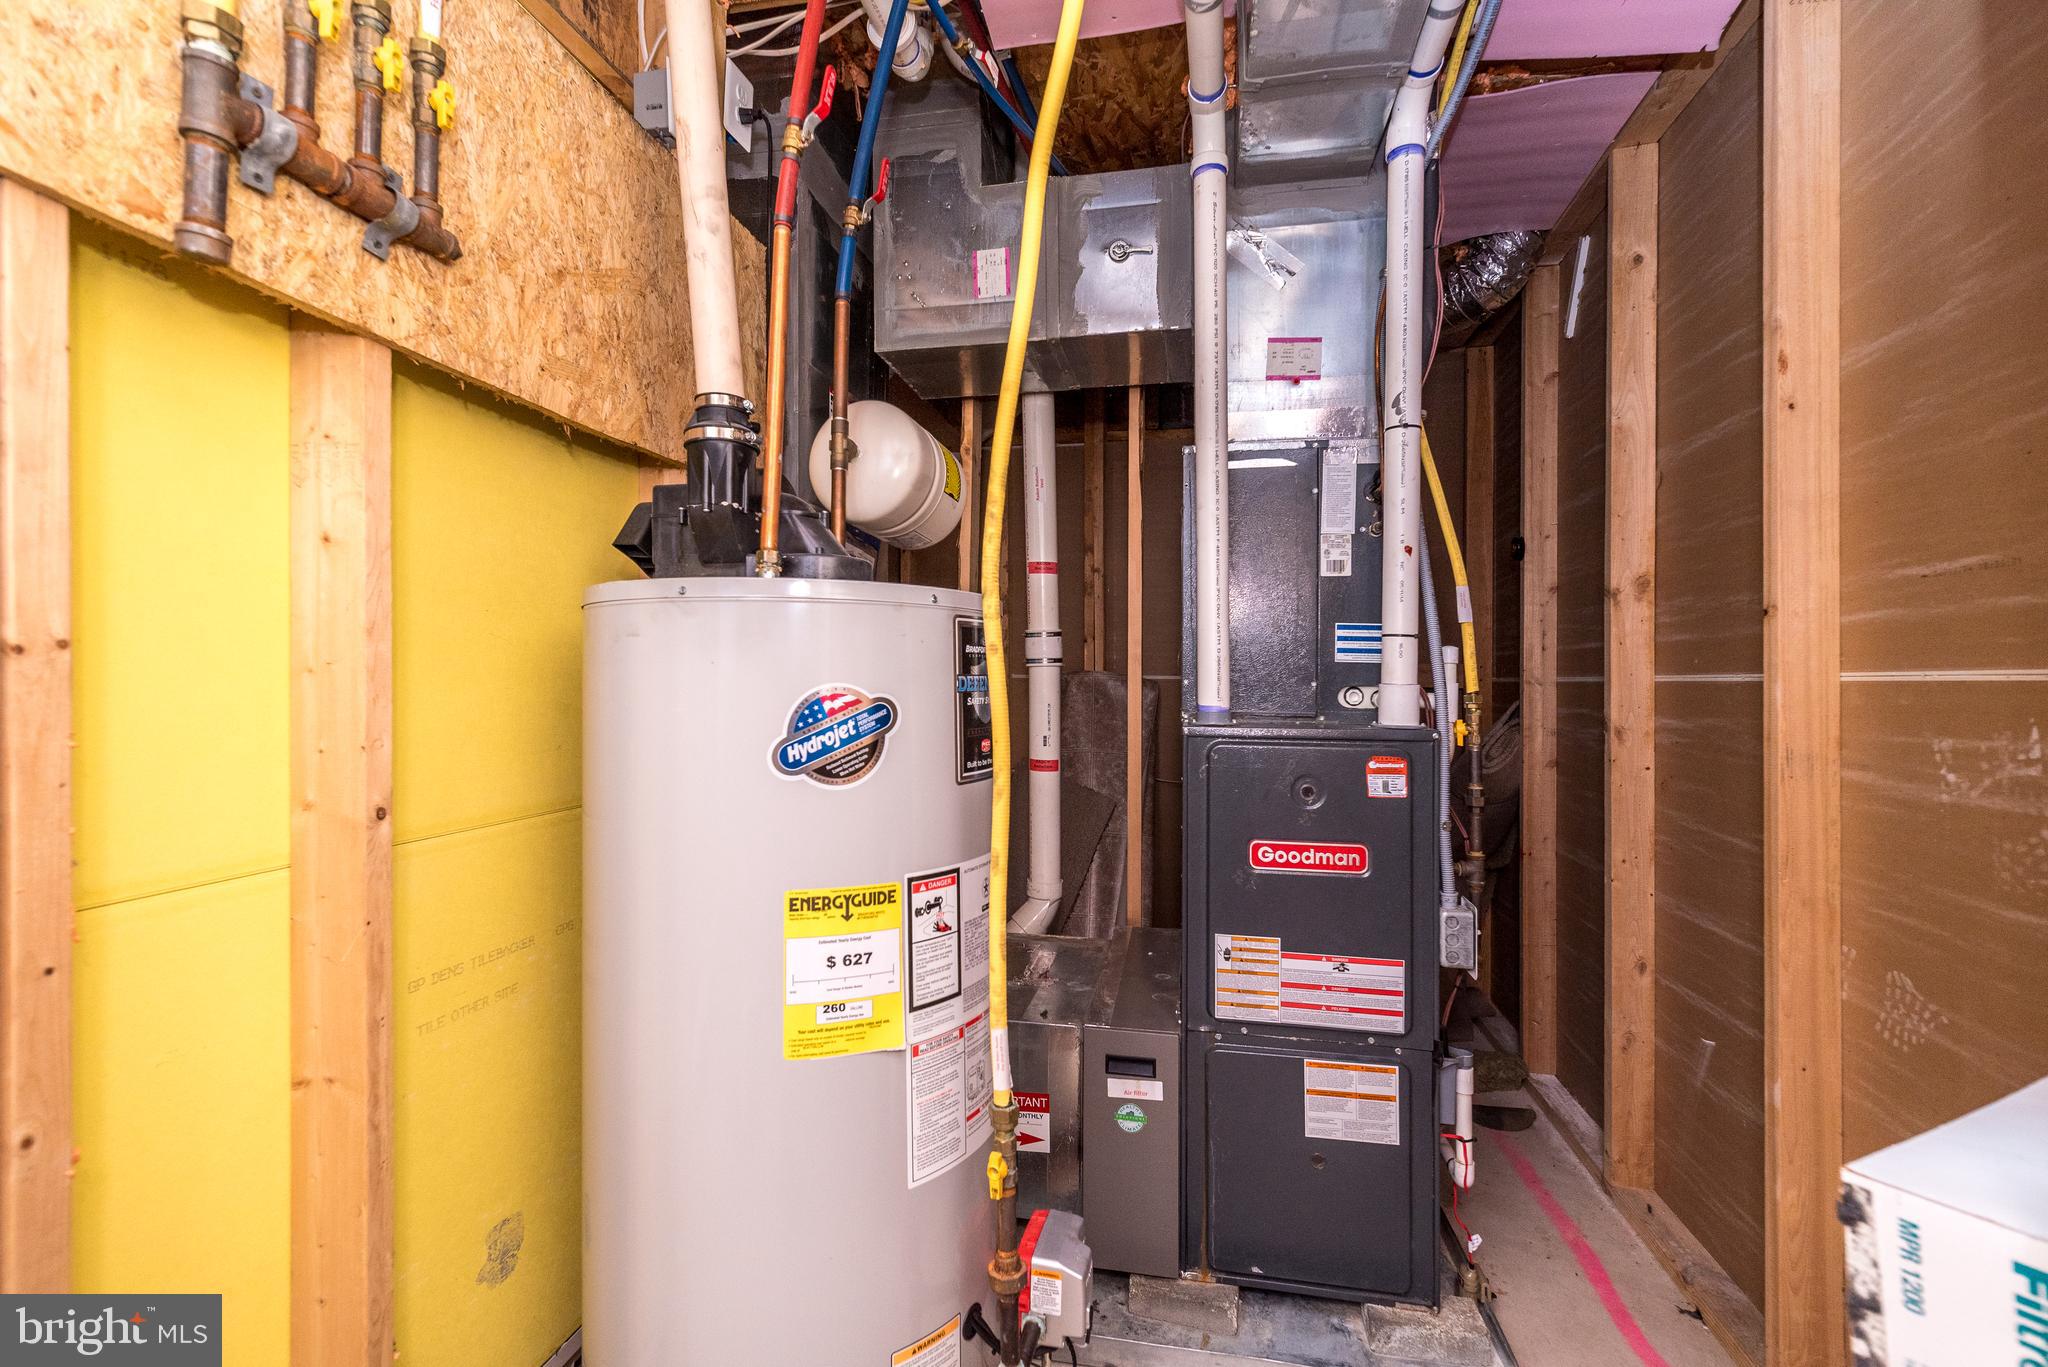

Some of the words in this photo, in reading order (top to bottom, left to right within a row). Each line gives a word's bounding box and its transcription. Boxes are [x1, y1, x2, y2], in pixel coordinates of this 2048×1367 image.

[966, 644, 986, 654] BRADFO
[967, 696, 984, 706] SAFETY
[786, 718, 856, 763] Hydrojet
[966, 760, 977, 768] Built
[1257, 846, 1360, 866] Goodman
[928, 879, 952, 890] DANGER
[789, 890, 896, 914] ENERGYGUIDE
[826, 956, 836, 969] $
[842, 952, 873, 966] 627
[416, 1015, 446, 1036] TILE
[450, 996, 489, 1022] OTHER
[823, 1003, 846, 1014] 260
[1898, 1217, 1922, 1265] MPR
[1901, 1268, 1926, 1317] 1200
[917, 1331, 946, 1352] WARNING
